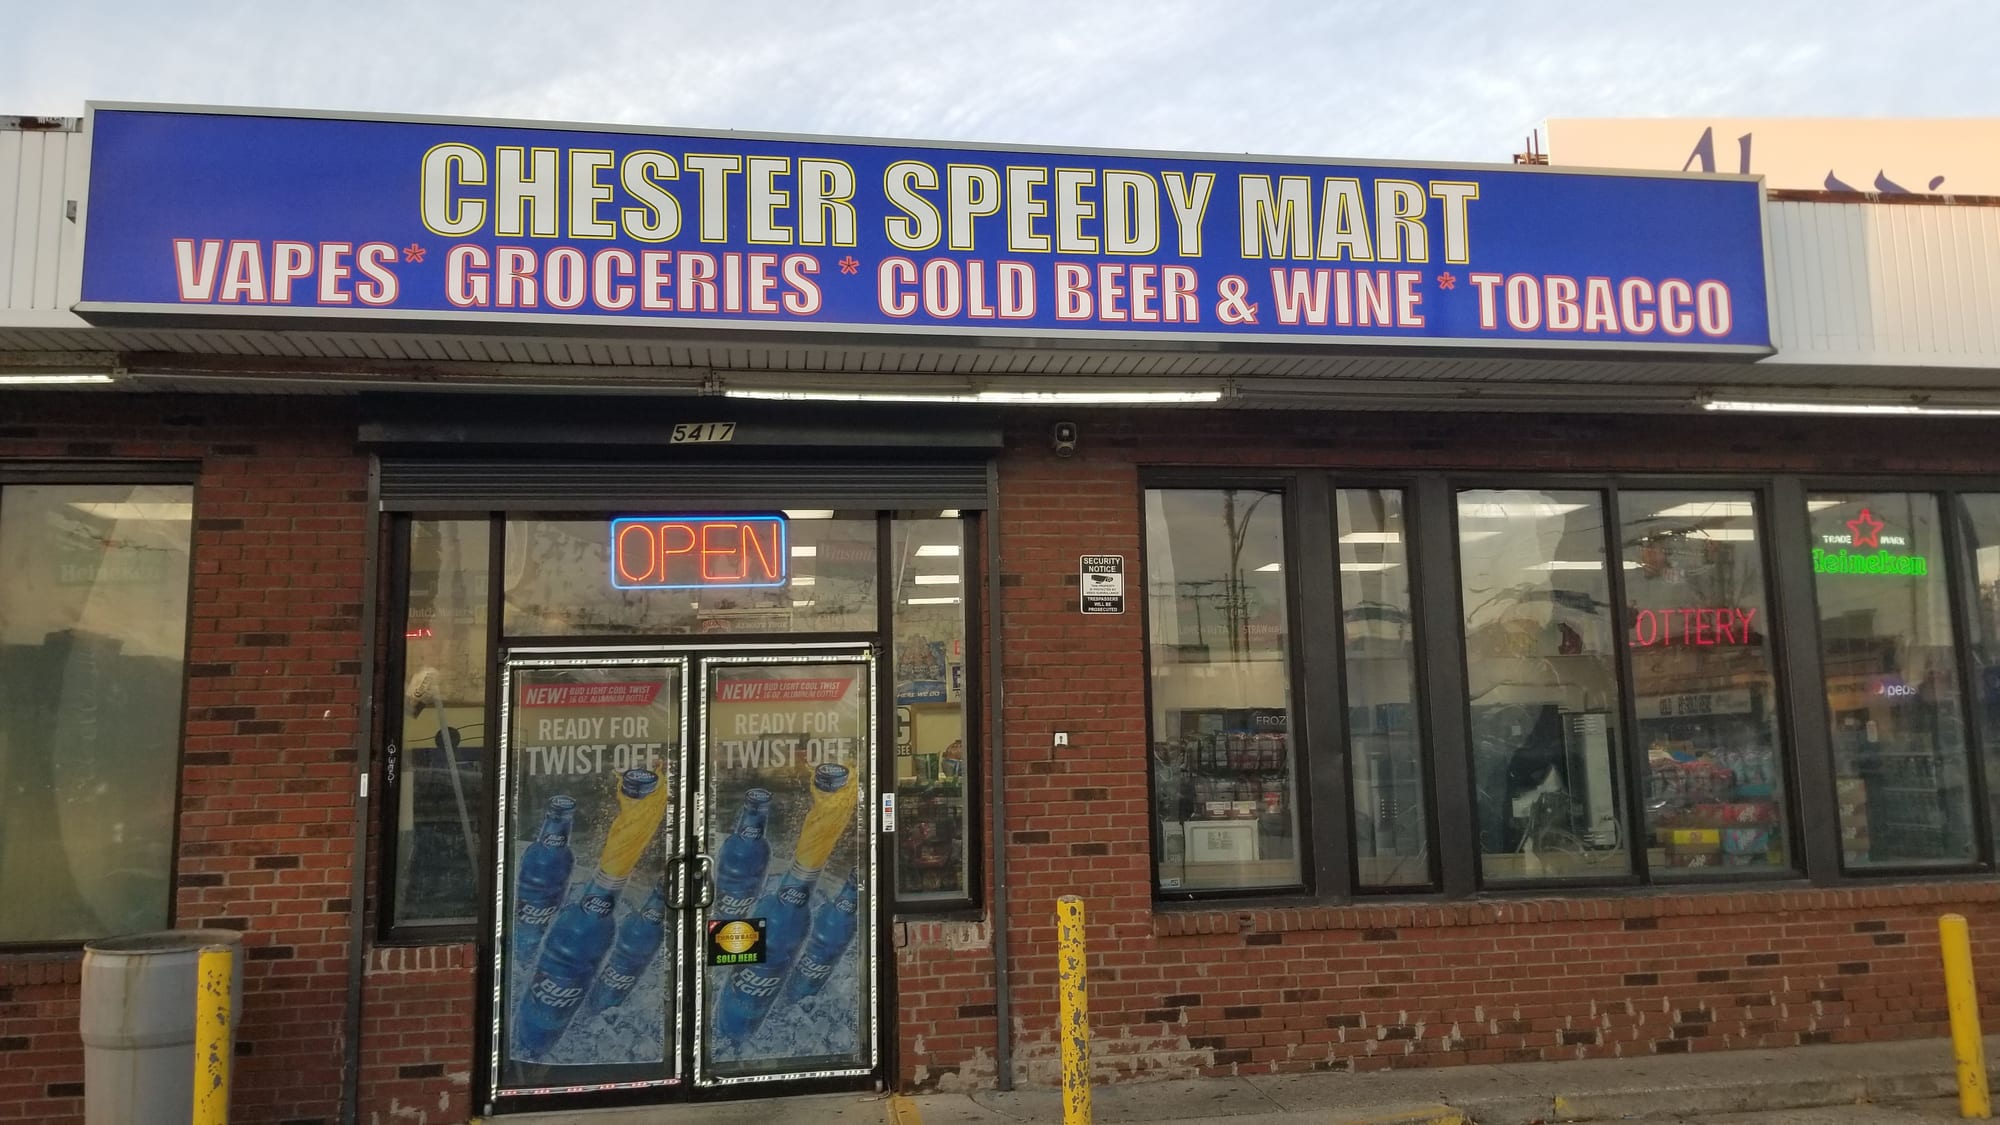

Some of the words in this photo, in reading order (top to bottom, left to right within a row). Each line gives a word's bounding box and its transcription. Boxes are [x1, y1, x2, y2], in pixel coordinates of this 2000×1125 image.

[420, 142, 857, 248] CHESTER
[884, 159, 1216, 258] SPEEDY
[1238, 174, 1480, 265] MART
[445, 244, 822, 316] GROCERIES
[877, 257, 1037, 320] COLD
[1055, 263, 1200, 324] BEER
[1216, 275, 1259, 325] &
[1269, 268, 1425, 329] WINE
[1469, 272, 1733, 338] TOBACCO
[673, 424, 734, 443] 5417
[1822, 535, 1852, 544] TRADE
[1879, 535, 1905, 546] MARK
[618, 523, 778, 583] OPEN
[1083, 557, 1121, 565] SECURITY
[1088, 565, 1118, 573] NOTICE
[1629, 607, 1757, 646] OTTERY
[569, 687, 585, 696] BUD
[586, 686, 608, 695] LIGHT
[608, 685, 628, 695] COOL
[629, 685, 651, 694] TWIST
[721, 683, 763, 700] NEW!
[764, 682, 779, 691] BUD
[779, 682, 800, 691] LIGHT
[800, 682, 818, 690] COOL
[820, 681, 841, 690] TWIST
[1887, 684, 1918, 699] peps
[525, 687, 569, 705] NEW!
[538, 717, 604, 741] READY
[609, 716, 650, 739] FOR
[735, 712, 797, 735] READY
[802, 711, 841, 734] FOR
[1256, 715, 1288, 727] FROZ
[525, 744, 607, 776] TWIST
[613, 743, 662, 773] OFF
[722, 738, 800, 770] TWIST
[806, 737, 852, 767] OFF
[591, 896, 612, 909] BUD
[721, 895, 755, 908] BUD
[780, 892, 806, 905] LIGHT
[788, 888, 807, 900] BUD
[522, 904, 558, 918] BUD
[584, 902, 611, 915] LIGHT
[716, 954, 737, 964] SOLD
[738, 952, 758, 962] HERE
[801, 957, 831, 972] BUD
[605, 966, 636, 983] BUD
[739, 968, 781, 988] BUD
[531, 983, 583, 1008] LIGHT
[540, 978, 584, 998] BUD
